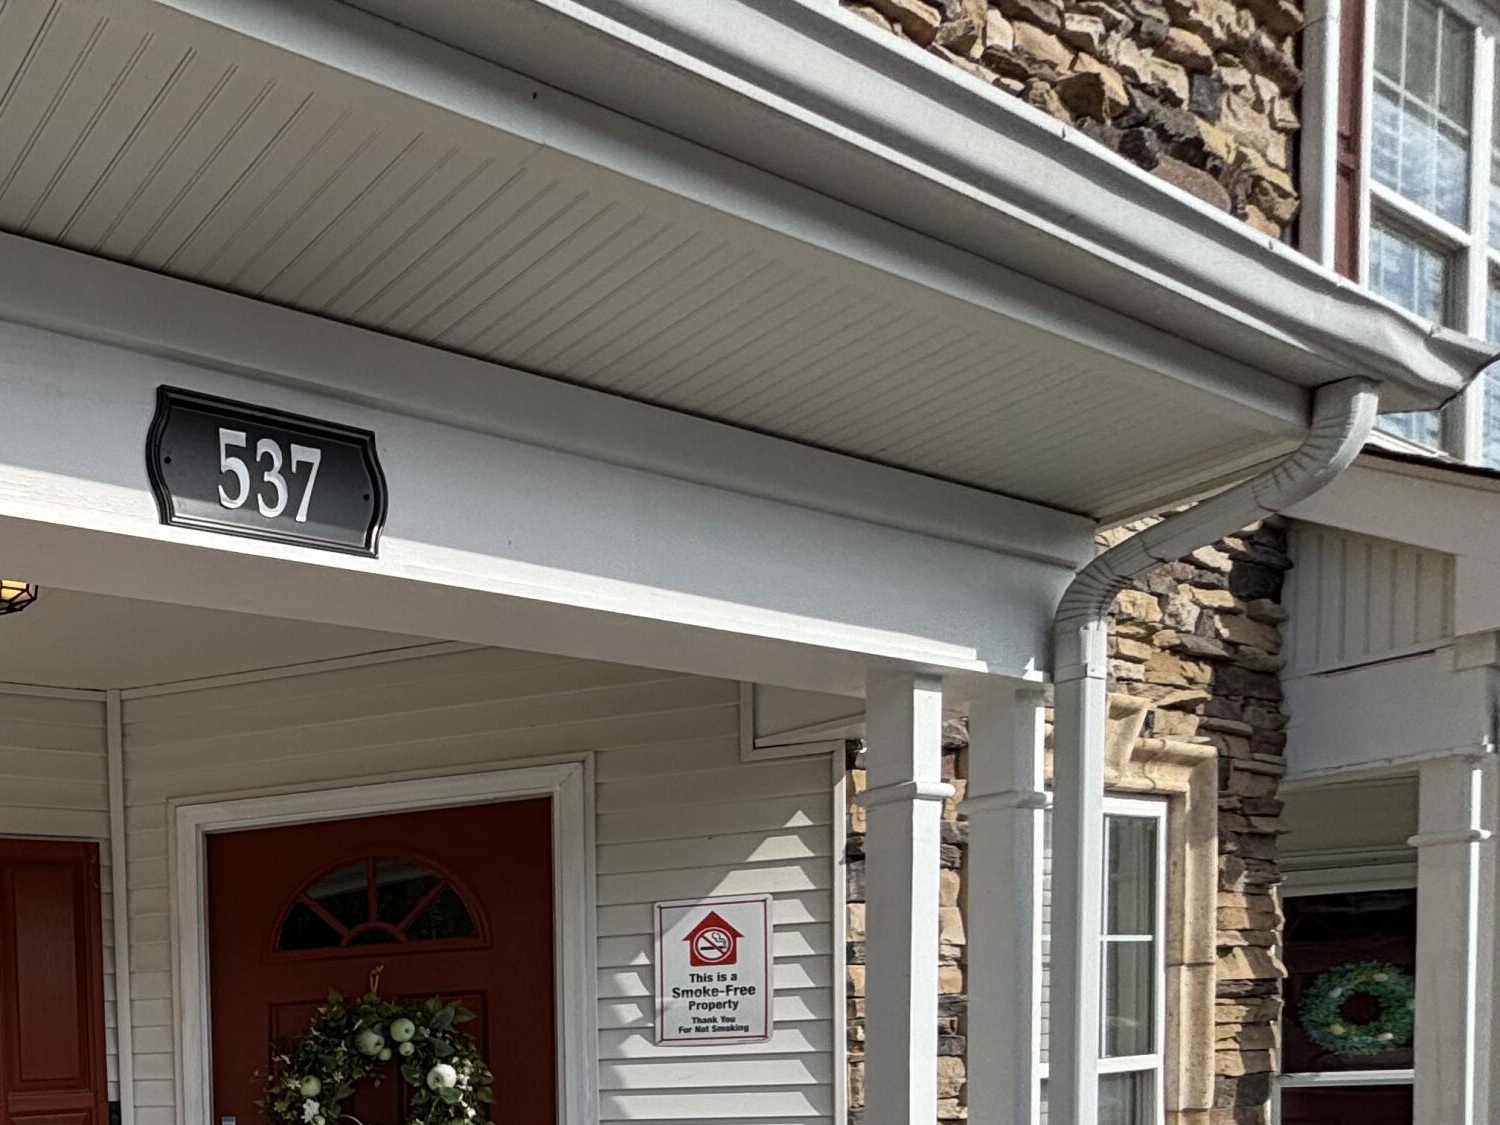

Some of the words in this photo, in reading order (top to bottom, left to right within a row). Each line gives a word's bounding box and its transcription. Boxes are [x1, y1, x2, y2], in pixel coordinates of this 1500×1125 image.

[217, 427, 322, 523] 537
[689, 973, 713, 983] This
[717, 972, 728, 982] is
[730, 973, 738, 981] a
[672, 985, 756, 999] Smoke-Free
[688, 1000, 739, 1012] Property
[692, 1016, 718, 1024] Thank
[720, 1015, 736, 1023] You
[678, 1025, 692, 1034] For
[694, 1025, 709, 1033] Not
[711, 1023, 749, 1033] Smoking
